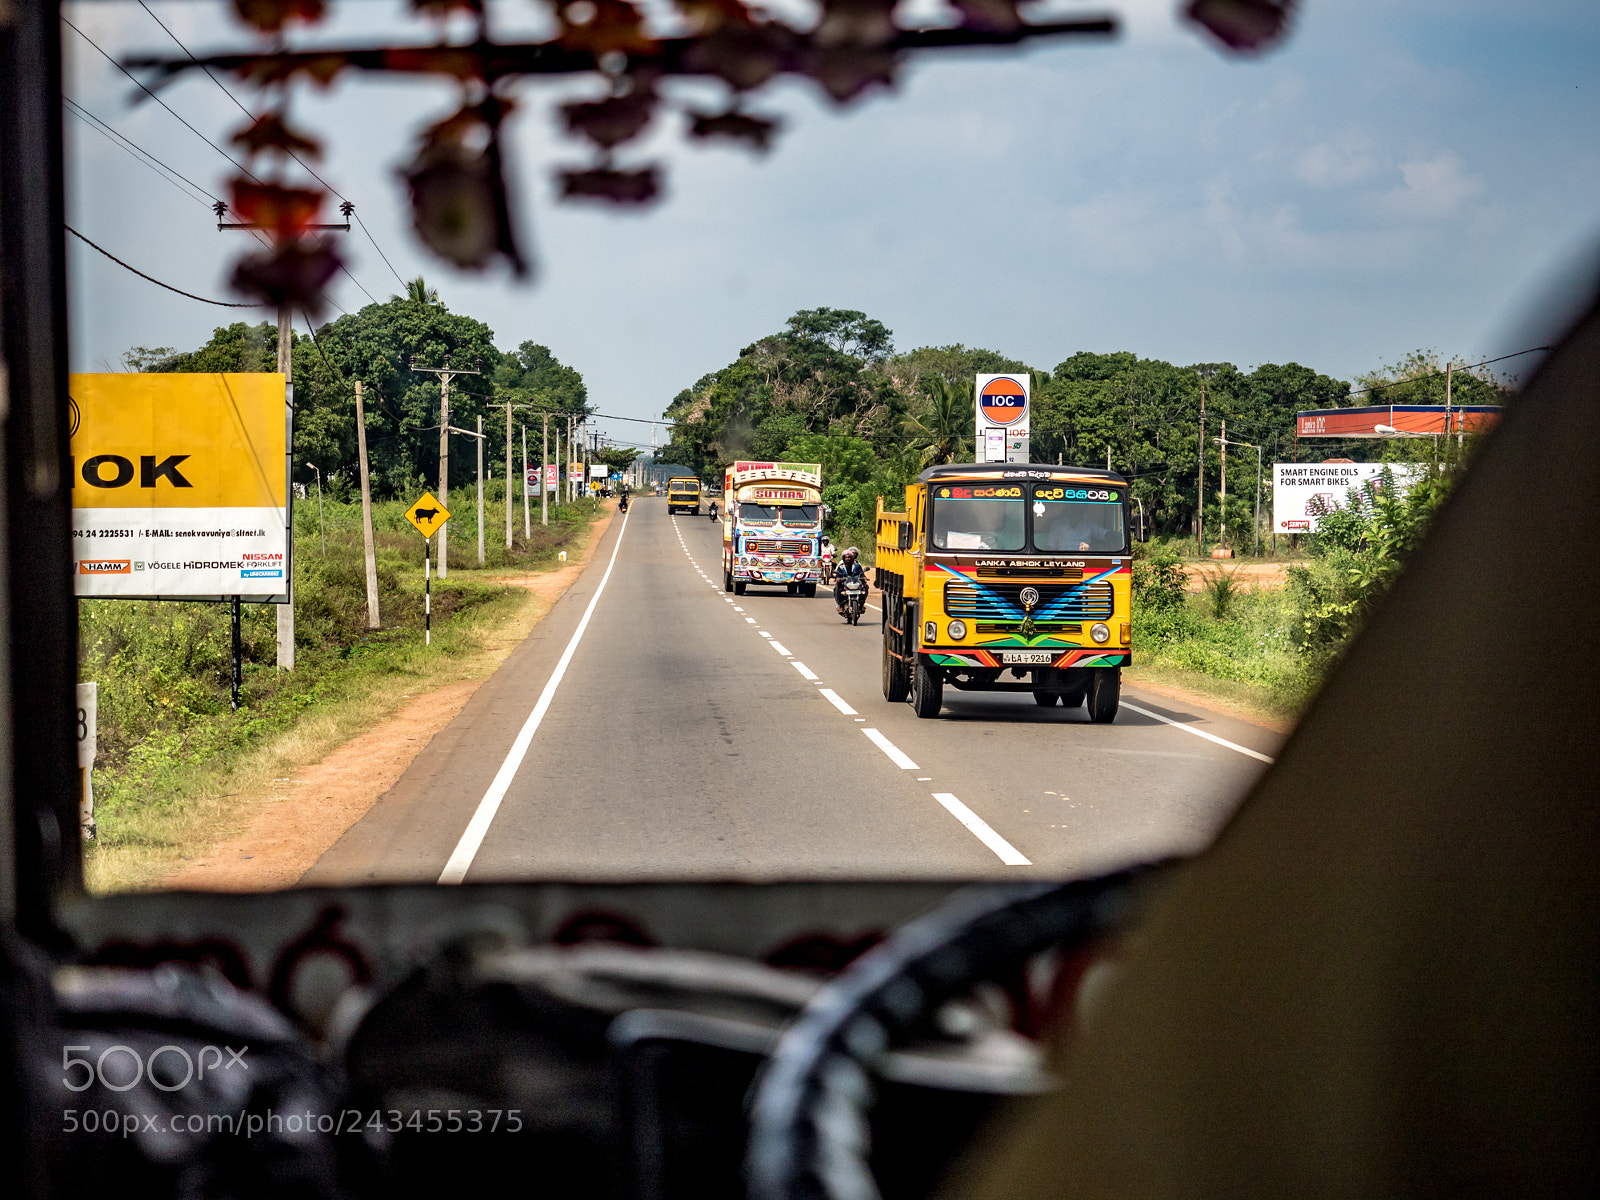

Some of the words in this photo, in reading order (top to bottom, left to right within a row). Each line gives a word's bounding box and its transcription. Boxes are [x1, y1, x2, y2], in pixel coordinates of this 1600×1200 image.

[992, 396, 1014, 406] IOC
[1009, 429, 1026, 437] IOC
[736, 462, 774, 472] SUTHAN
[777, 464, 819, 475] TRANSPORT
[1280, 468, 1307, 476] SMART
[1309, 468, 1339, 476] ENGINE
[1340, 468, 1358, 476] OILS
[1280, 478, 1296, 486] FOR
[1298, 478, 1325, 486] SMART
[1327, 478, 1349, 486] BIKES
[756, 490, 804, 499] SUTHAN
[86, 530, 97, 538] 24
[99, 530, 134, 538] 2225531
[145, 529, 173, 538] E-MAIL:
[88, 563, 122, 571] HAMM
[148, 561, 181, 570] VÖGELE
[1044, 560, 1085, 568] LEYLAND
[1030, 654, 1050, 662] 9216
